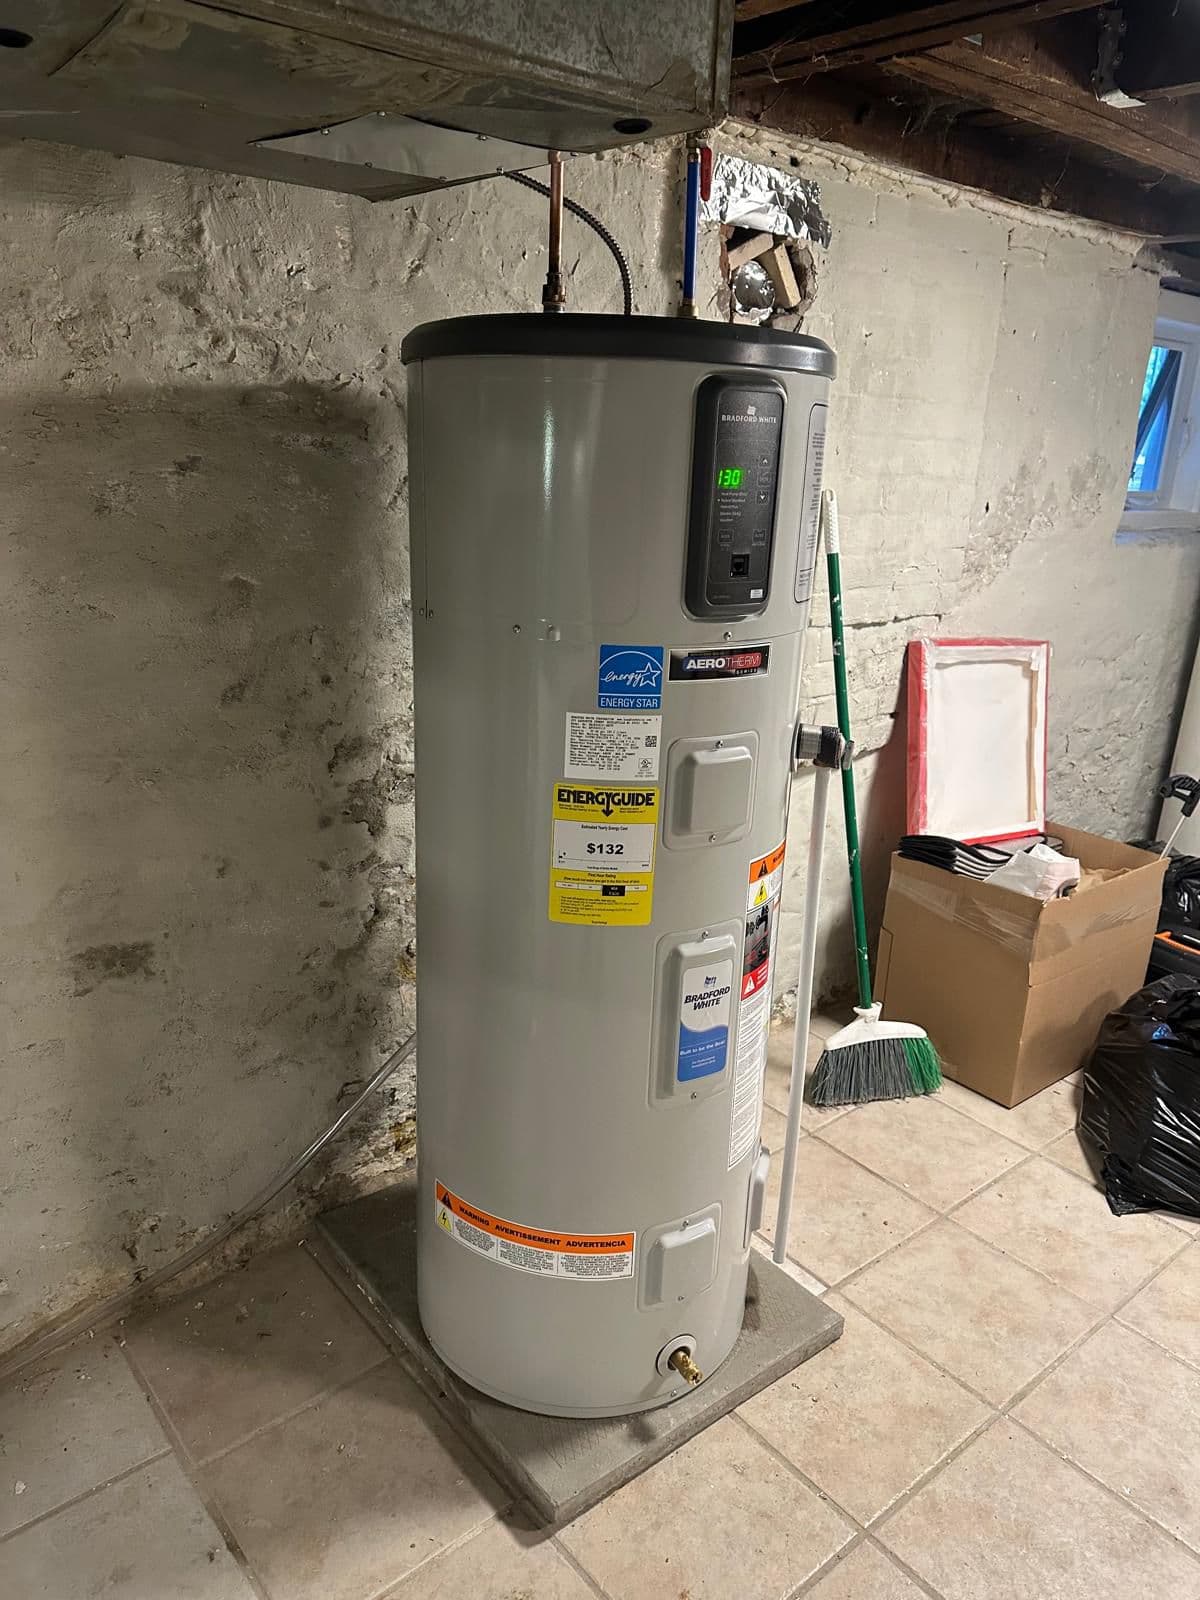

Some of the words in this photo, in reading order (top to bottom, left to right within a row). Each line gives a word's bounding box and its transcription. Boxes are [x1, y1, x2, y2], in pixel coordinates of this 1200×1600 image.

[721, 414, 757, 423] BRADFORD
[759, 416, 777, 424] WHITE
[718, 469, 741, 486] 130
[686, 653, 760, 670] AEROTHERM
[601, 669, 642, 687] energy
[600, 697, 635, 707] ENERGY
[636, 698, 658, 708] STAR
[557, 788, 655, 807] ENERGYGUIDE
[586, 843, 624, 855] $132
[684, 986, 731, 1004] BRADFORD
[693, 998, 721, 1011] WHITE
[459, 1206, 490, 1226] WARNING
[495, 1224, 561, 1245] AVERTISSEMENT
[566, 1240, 626, 1248] ADVERTENCIA
